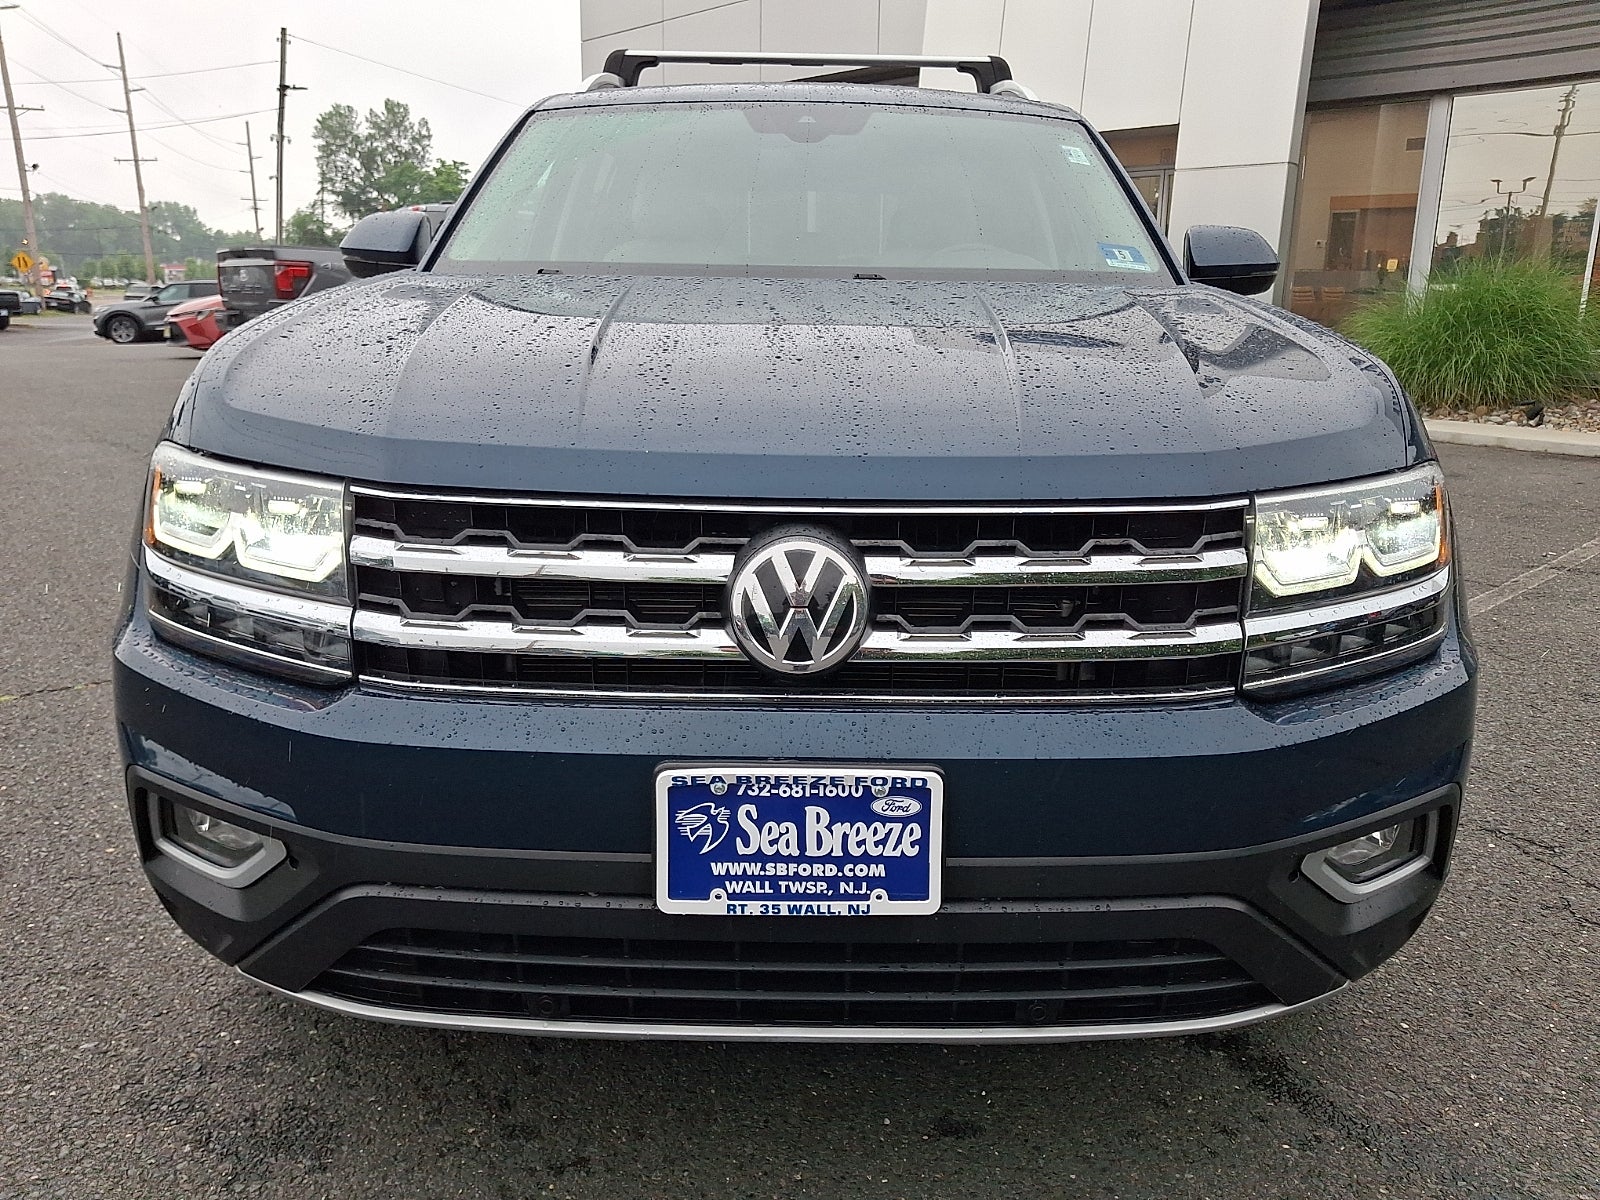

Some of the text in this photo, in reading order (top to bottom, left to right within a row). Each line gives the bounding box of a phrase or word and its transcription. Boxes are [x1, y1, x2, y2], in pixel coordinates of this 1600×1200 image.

[671, 775, 929, 789] SEA BREEZE FORD
[881, 799, 912, 813] Ford
[735, 804, 922, 857] Sea Breeze
[710, 862, 886, 877] WWW.SBFORD.COM
[725, 881, 774, 894] WALL
[839, 882, 871, 895] N.J.
[726, 903, 871, 916] RT. 35 WALL, NJ
